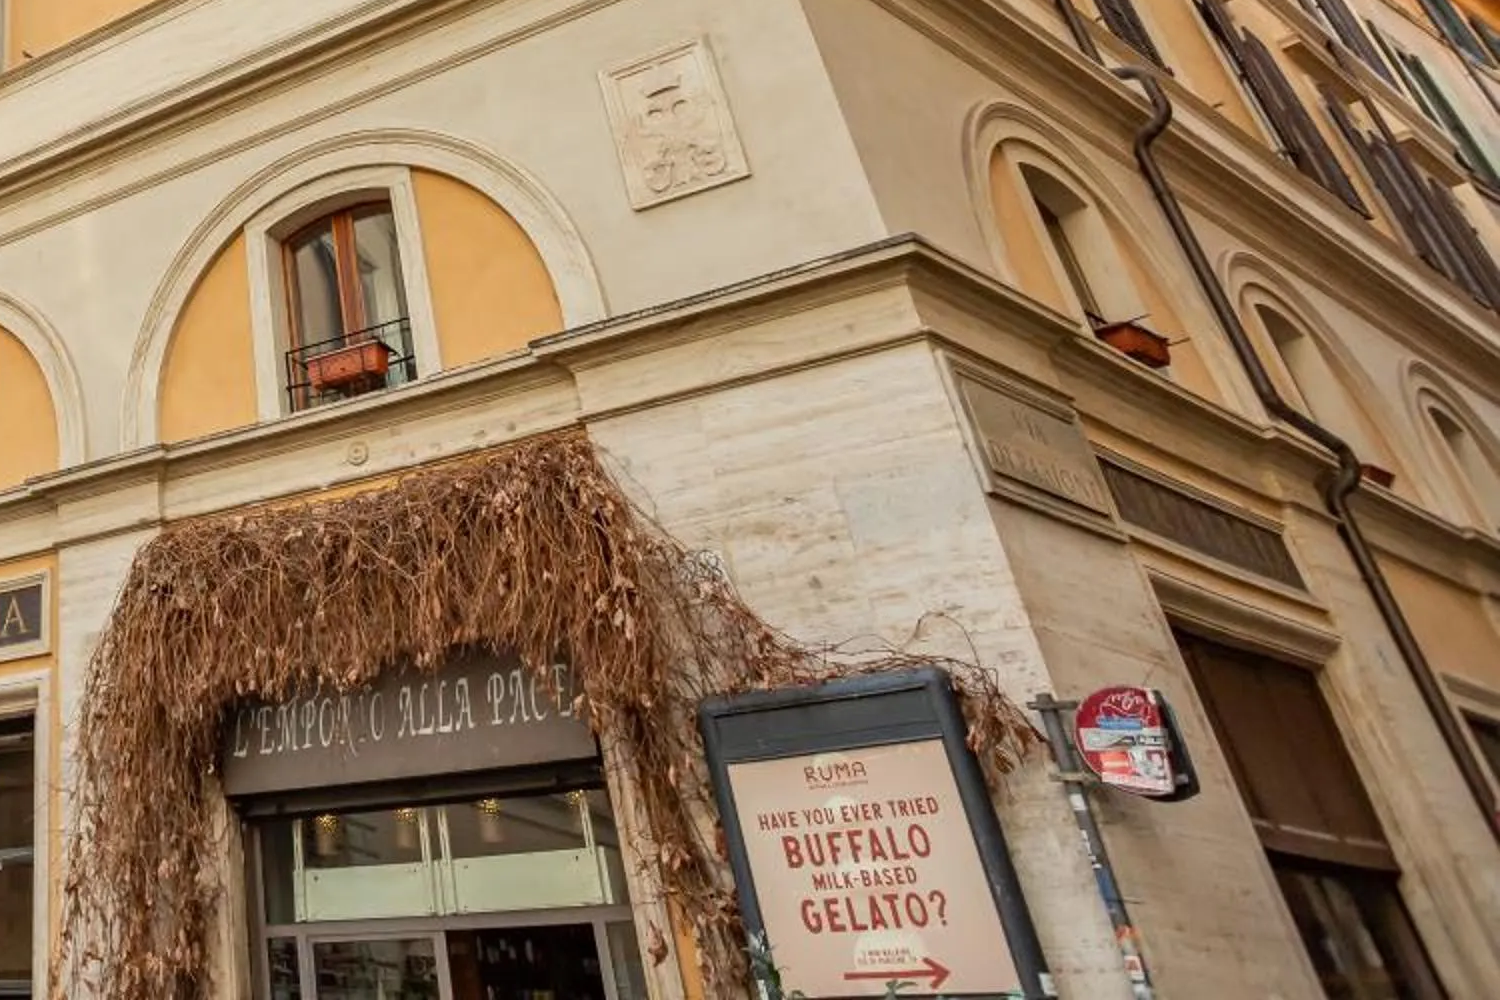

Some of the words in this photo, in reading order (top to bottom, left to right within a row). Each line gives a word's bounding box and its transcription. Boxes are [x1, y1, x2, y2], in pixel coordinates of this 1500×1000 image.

[397, 677, 476, 738] ALLA
[487, 663, 574, 726] PACE
[803, 761, 867, 782] RUMA
[757, 811, 799, 831] HAVE
[802, 807, 835, 825] YOU
[840, 802, 883, 823] EVER
[888, 796, 940, 819] TRIED
[781, 823, 931, 869] BUFFALO
[812, 866, 918, 891] MILK-BASED
[801, 889, 949, 934] GELATO?
